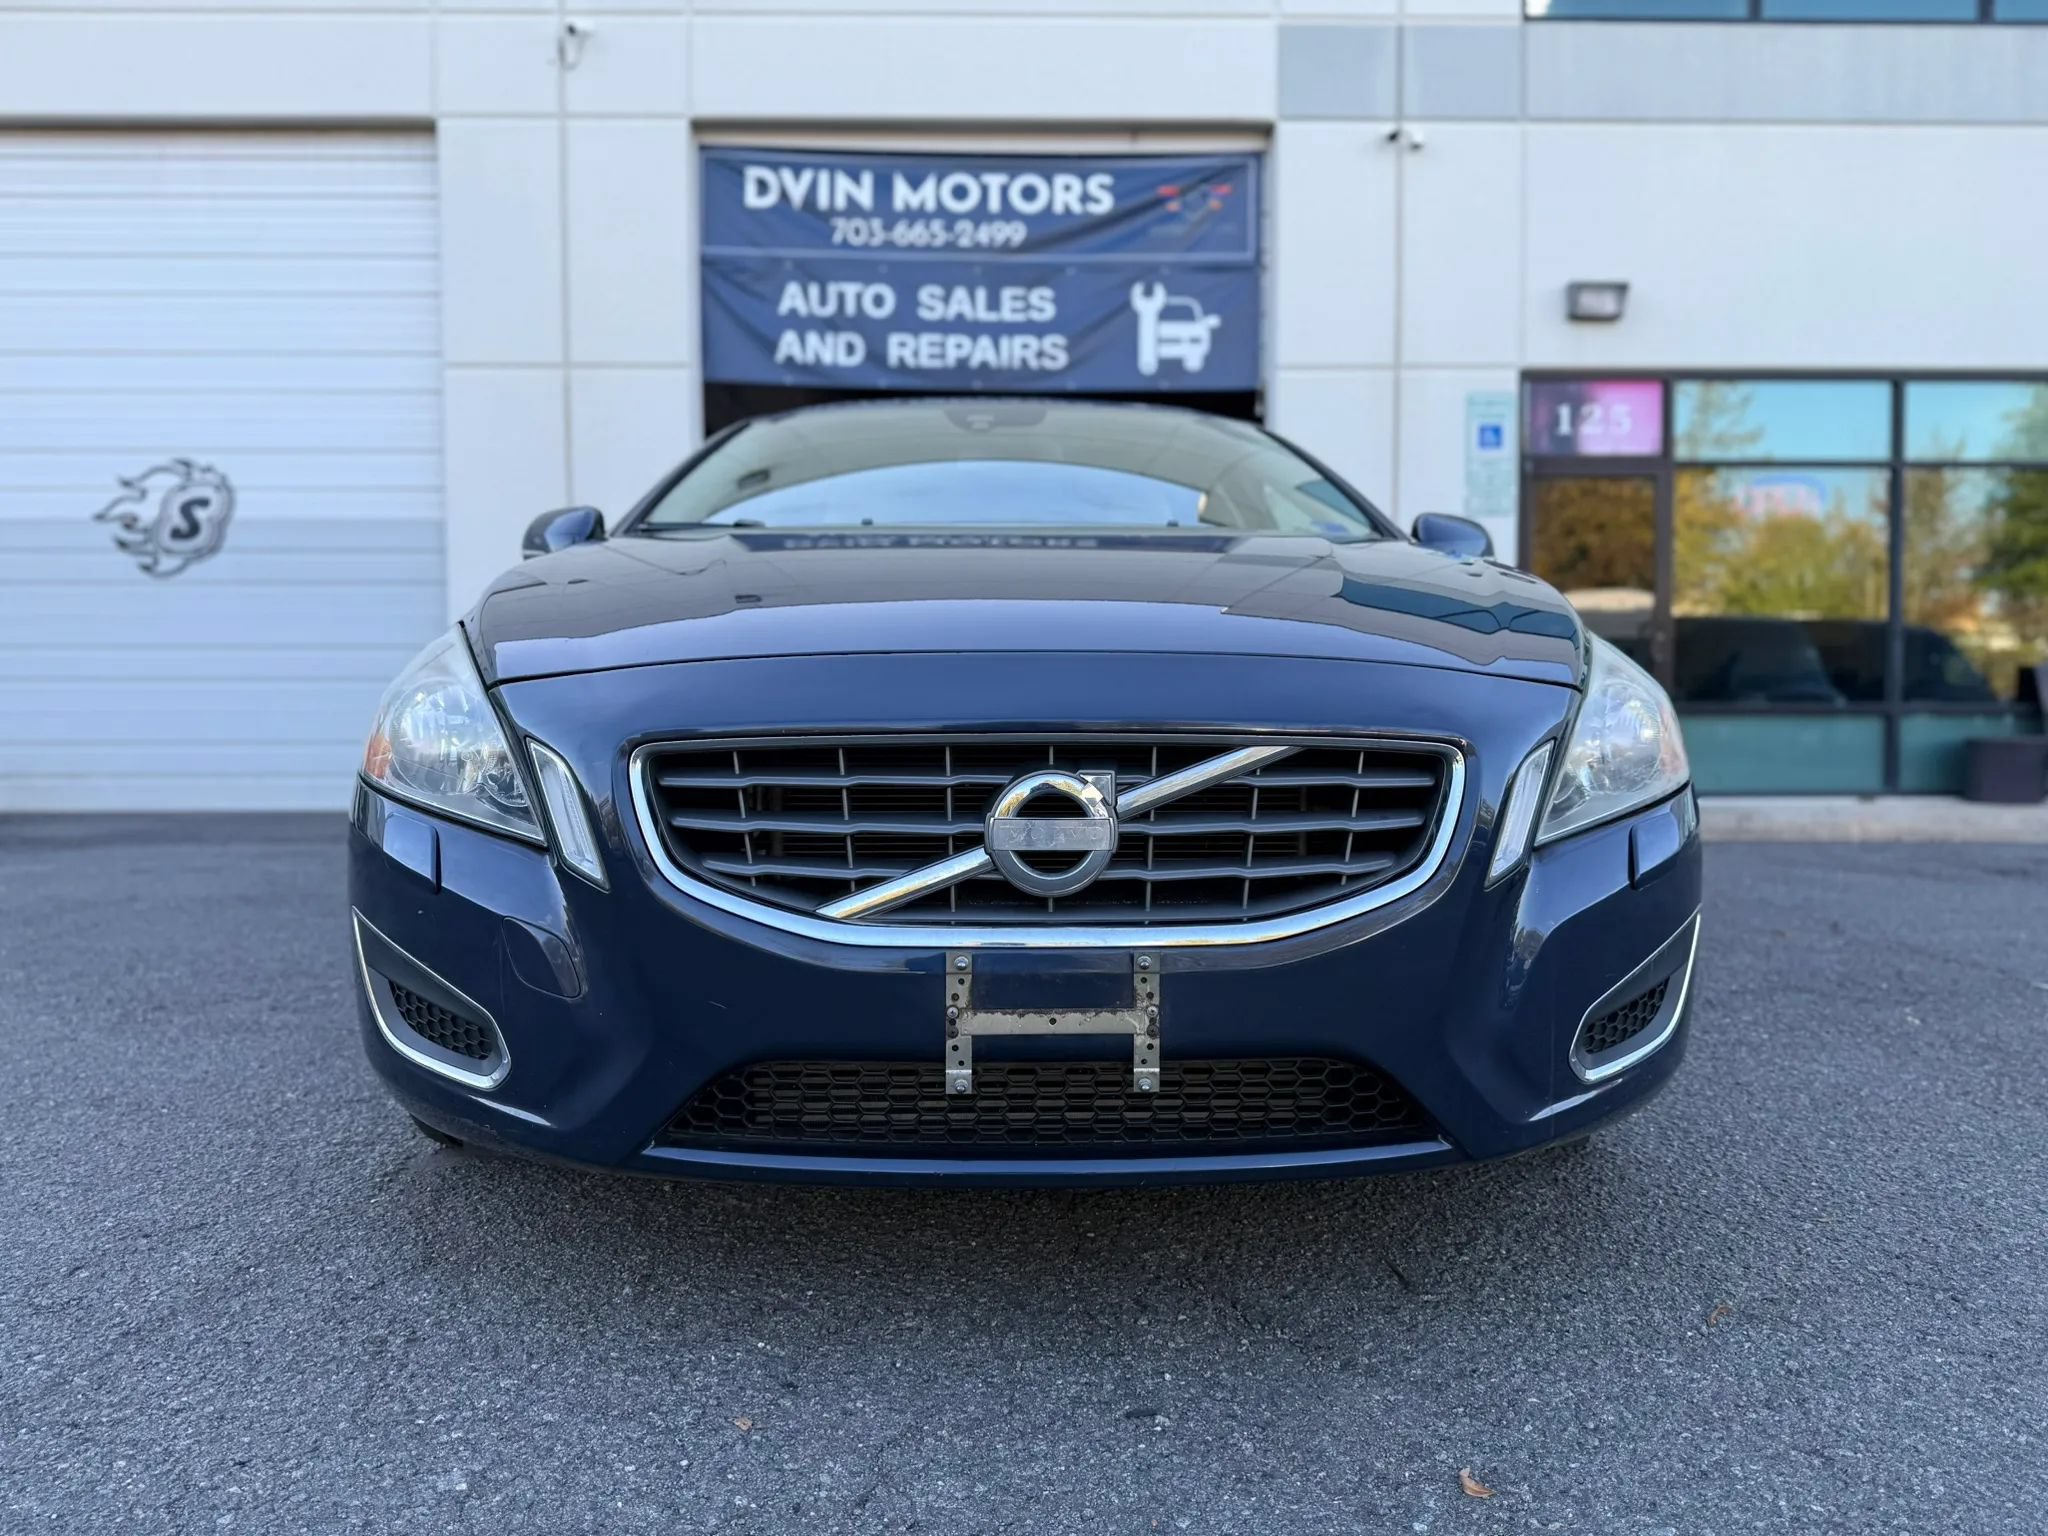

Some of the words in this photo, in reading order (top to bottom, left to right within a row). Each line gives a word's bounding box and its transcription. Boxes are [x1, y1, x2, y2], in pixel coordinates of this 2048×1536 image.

[743, 166, 873, 211] DVIN
[893, 171, 1115, 215] MOTORS
[830, 217, 1027, 248] 703-665-2499
[777, 281, 896, 319] AUTO
[916, 286, 1056, 323] SALES
[774, 331, 866, 367] AND
[886, 334, 1070, 370] REPAIRS
[1555, 402, 1632, 436] 125
[170, 497, 210, 540] S
